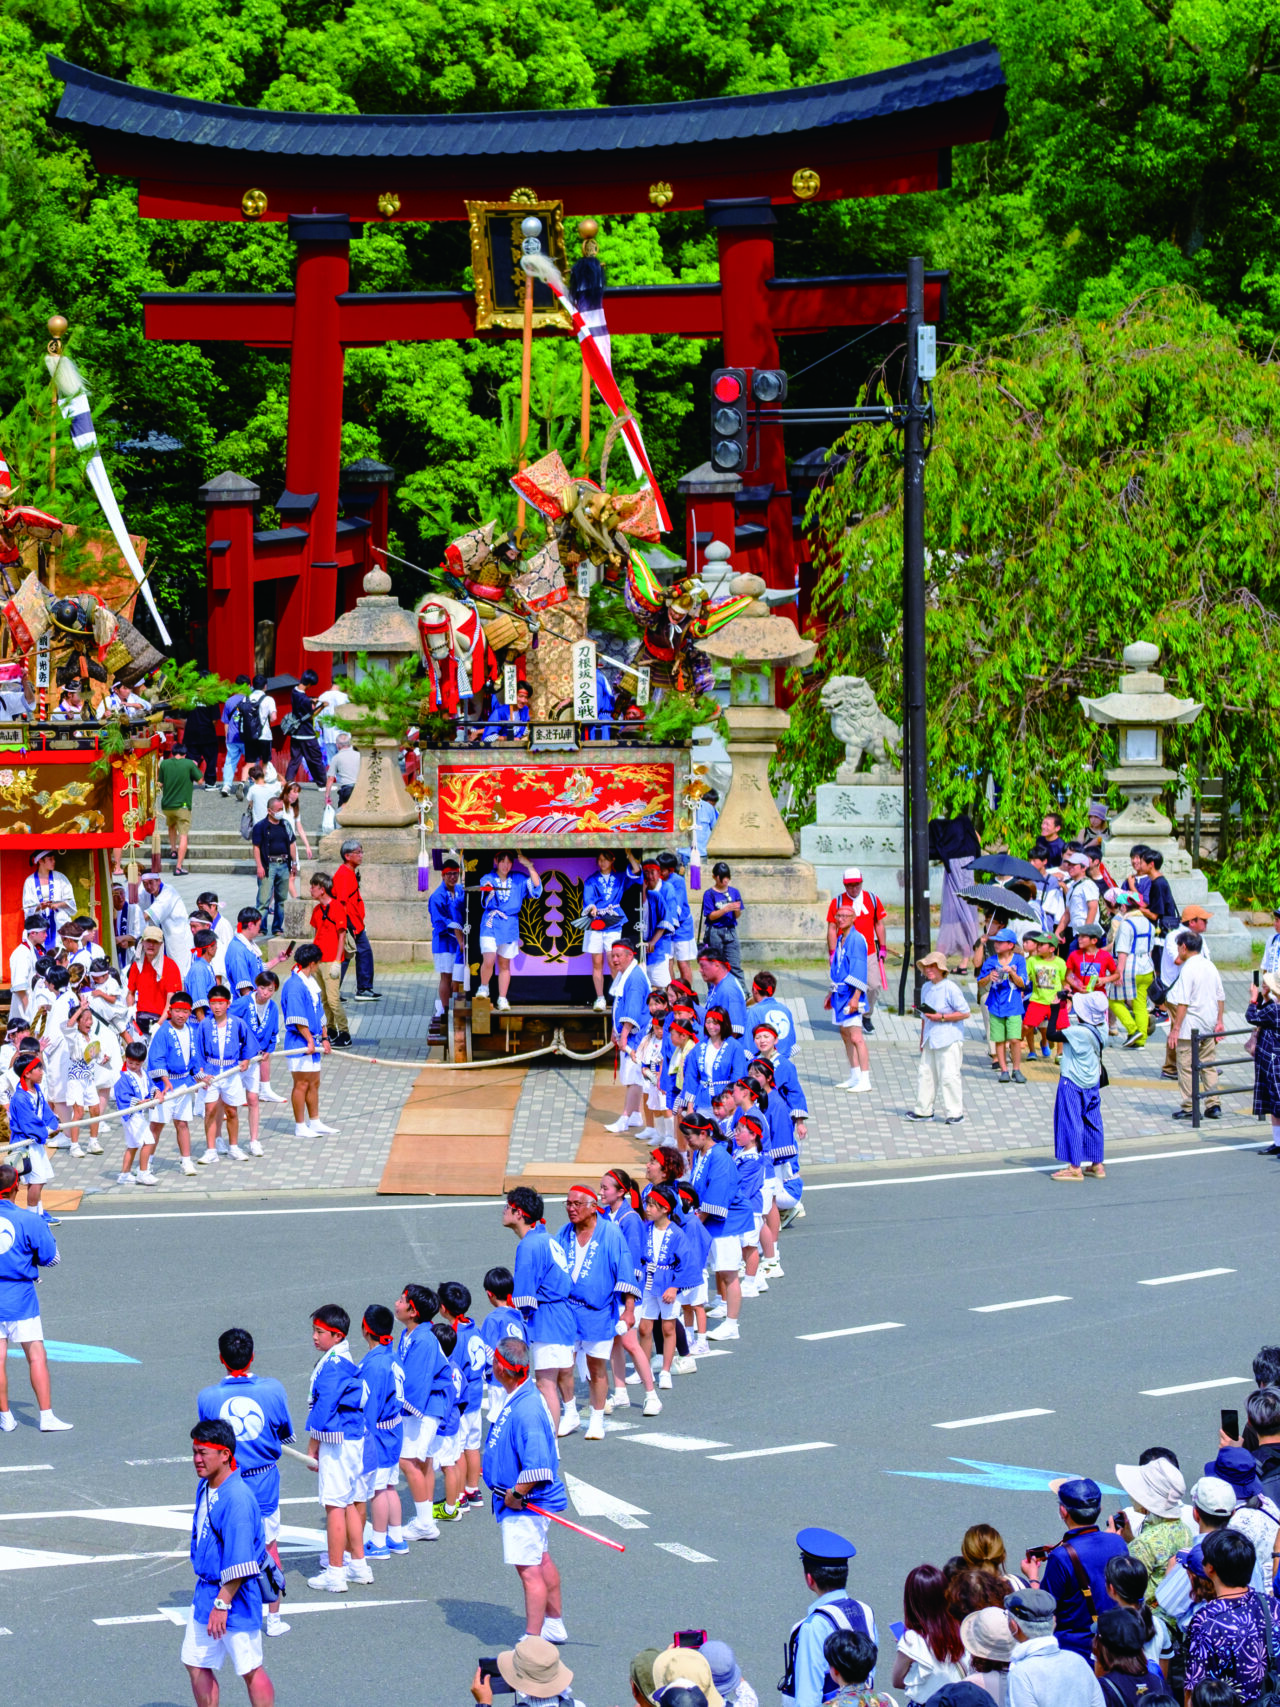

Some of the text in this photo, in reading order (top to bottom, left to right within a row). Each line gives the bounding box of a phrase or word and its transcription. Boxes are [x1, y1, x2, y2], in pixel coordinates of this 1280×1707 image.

[577, 646, 595, 718] 刀根坂の合戦
